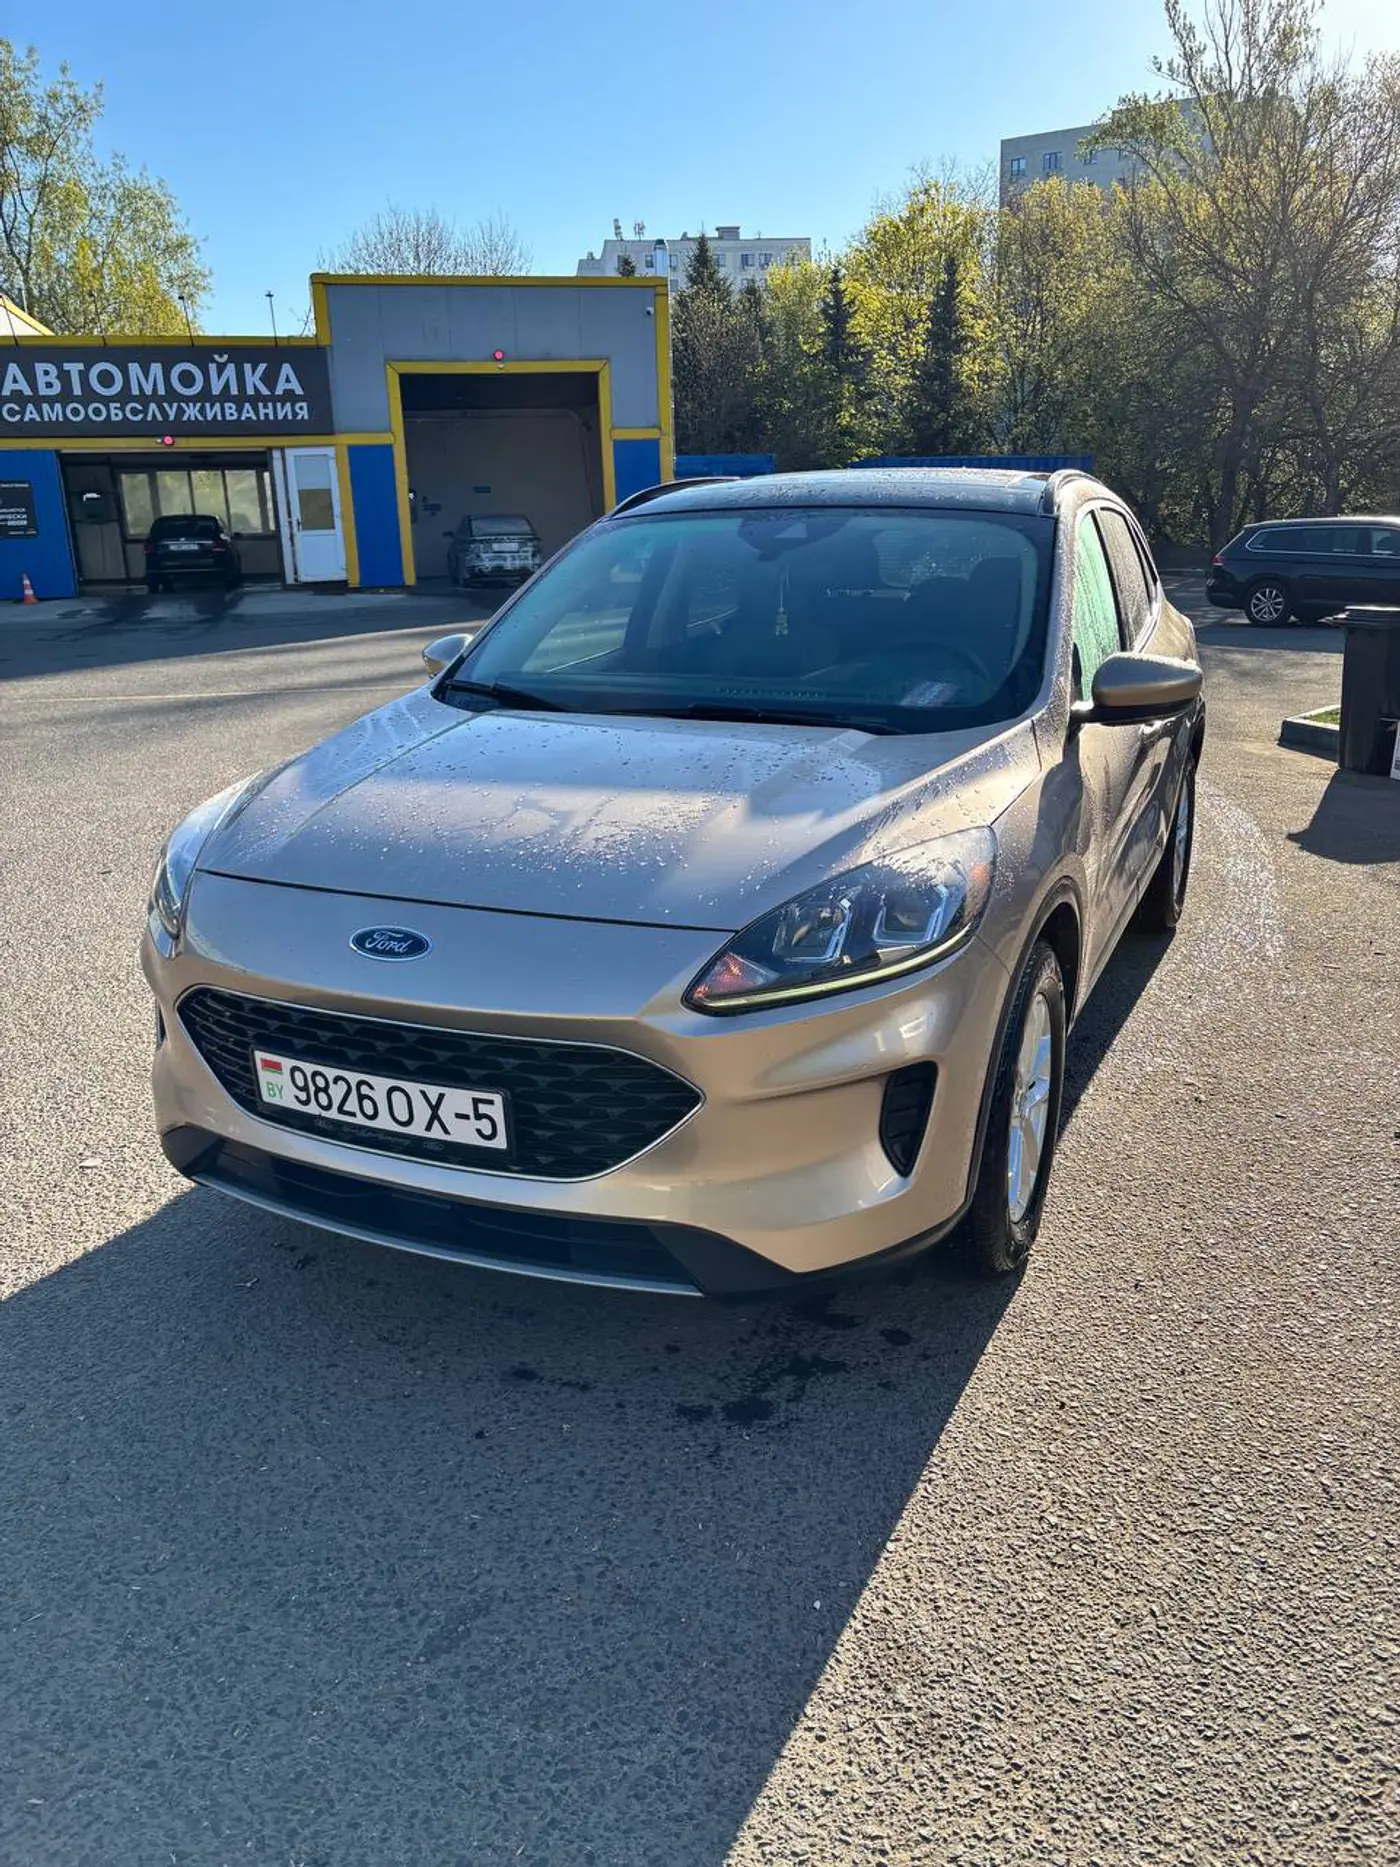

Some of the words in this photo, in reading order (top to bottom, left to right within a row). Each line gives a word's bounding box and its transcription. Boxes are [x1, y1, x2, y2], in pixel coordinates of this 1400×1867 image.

[1, 354, 304, 396] АВТОМОЙКА
[1, 402, 309, 421] САМООБСЛУЖИВАНИЯ
[365, 930, 414, 953] Ford
[265, 1081, 283, 1099] BY
